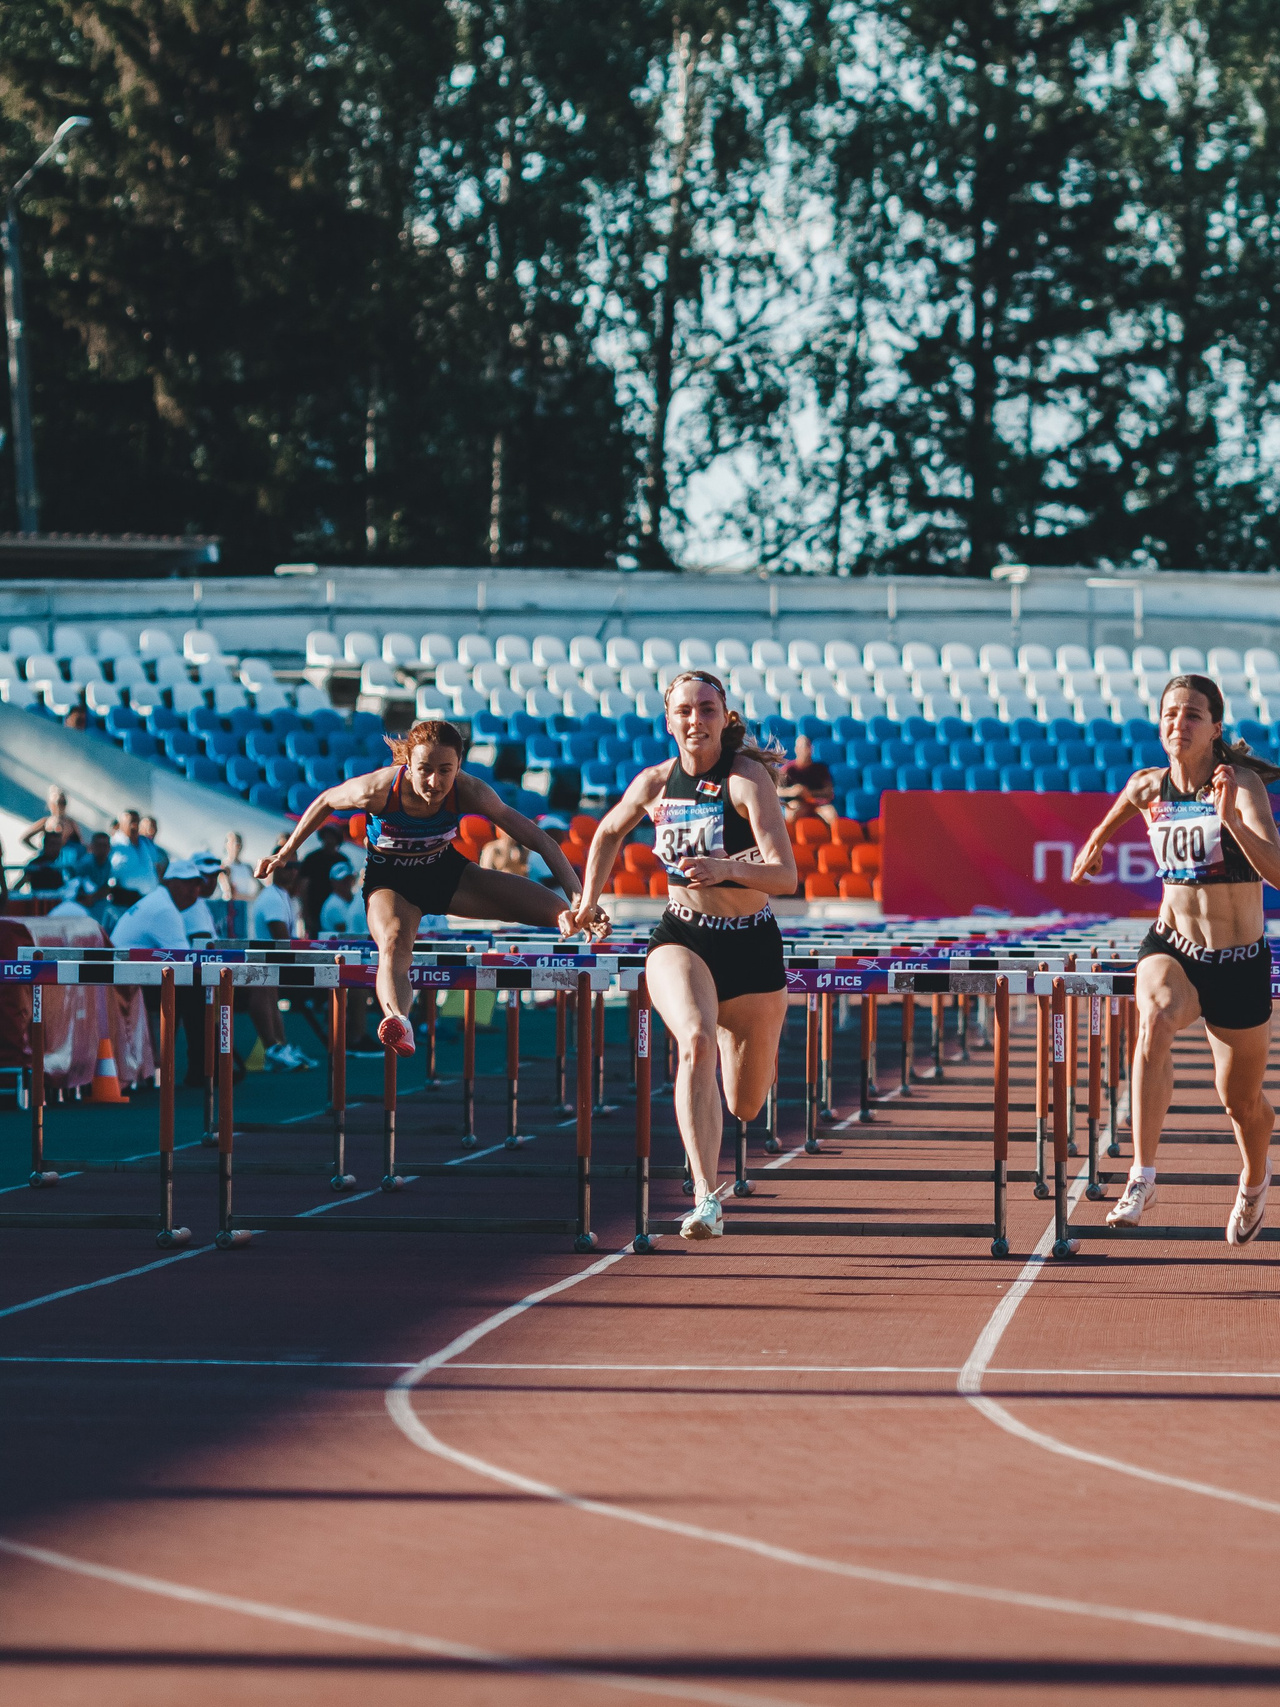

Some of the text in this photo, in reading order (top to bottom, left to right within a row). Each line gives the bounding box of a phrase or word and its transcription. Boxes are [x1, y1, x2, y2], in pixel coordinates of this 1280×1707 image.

[662, 827, 710, 863] 354
[1158, 825, 1206, 862] 700
[394, 853, 438, 867] NIKE
[668, 900, 773, 931] RO NIKE PR
[200, 954, 223, 963] ПСБ
[552, 958, 575, 967] ПСБ
[1167, 929, 1260, 965] NIKE PRO
[4, 964, 32, 975] ПСБ
[423, 971, 451, 982] ПСБ
[834, 975, 862, 986] ПСБ
[221, 1006, 229, 1048] POLANIK
[639, 1010, 647, 1052] POLANIK
[1055, 1015, 1063, 1057] POLANIK
